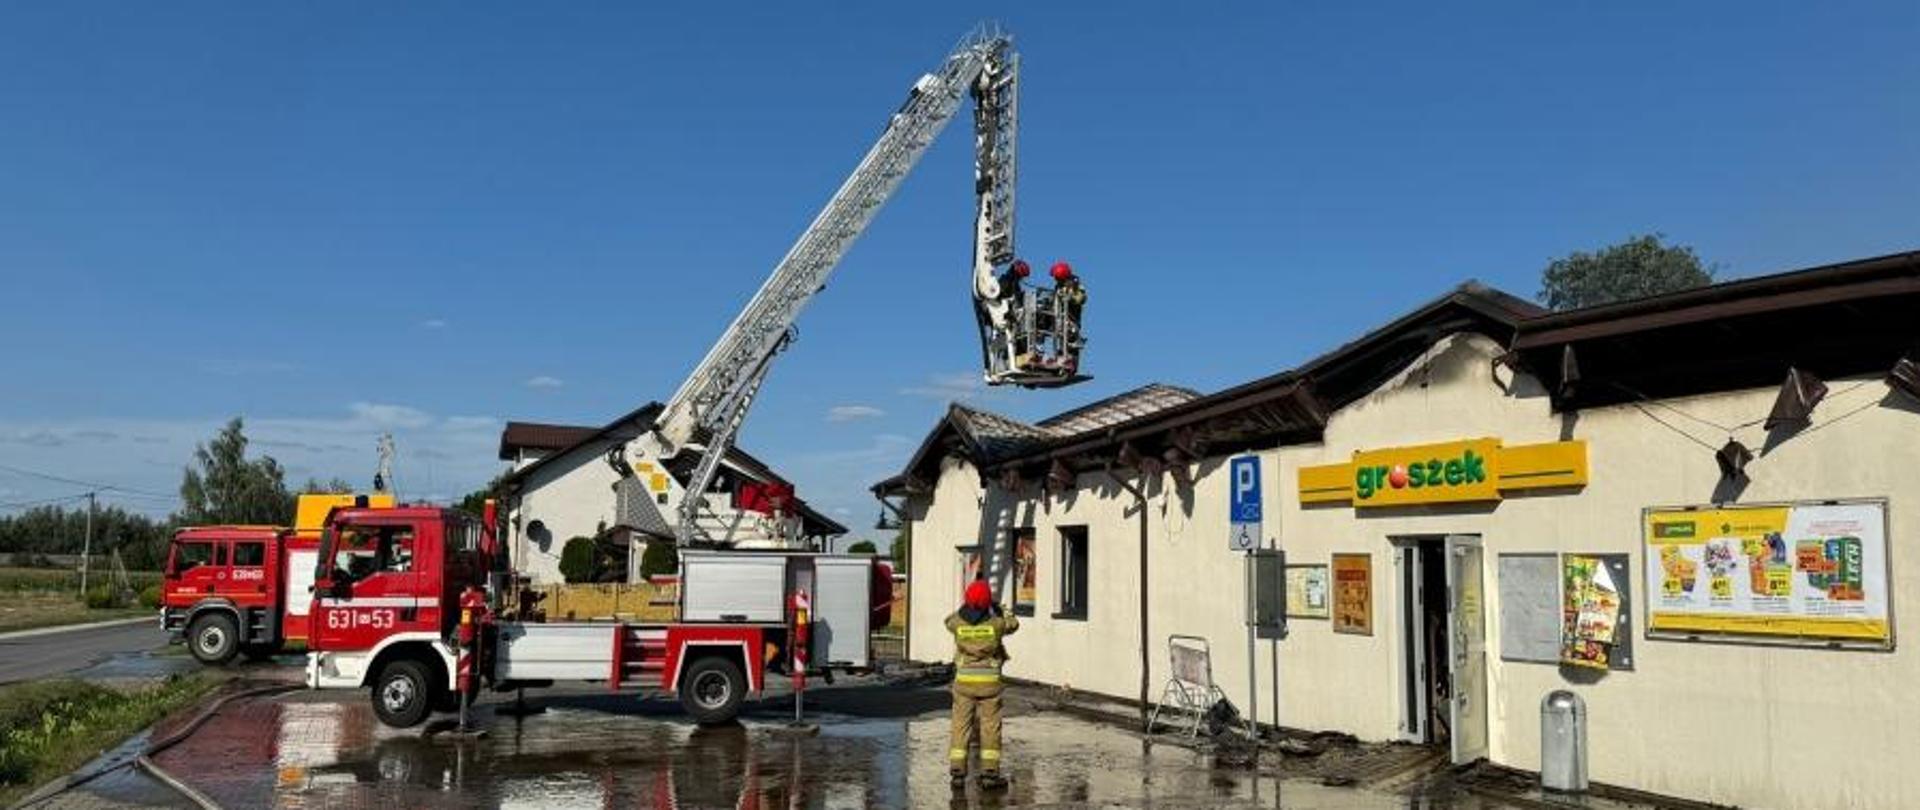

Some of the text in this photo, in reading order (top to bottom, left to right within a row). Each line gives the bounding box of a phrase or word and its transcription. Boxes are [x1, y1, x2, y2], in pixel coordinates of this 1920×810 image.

[1236, 462, 1255, 503] P
[1356, 450, 1486, 498] groszek
[328, 609, 357, 629] 631
[372, 609, 395, 629] 53
